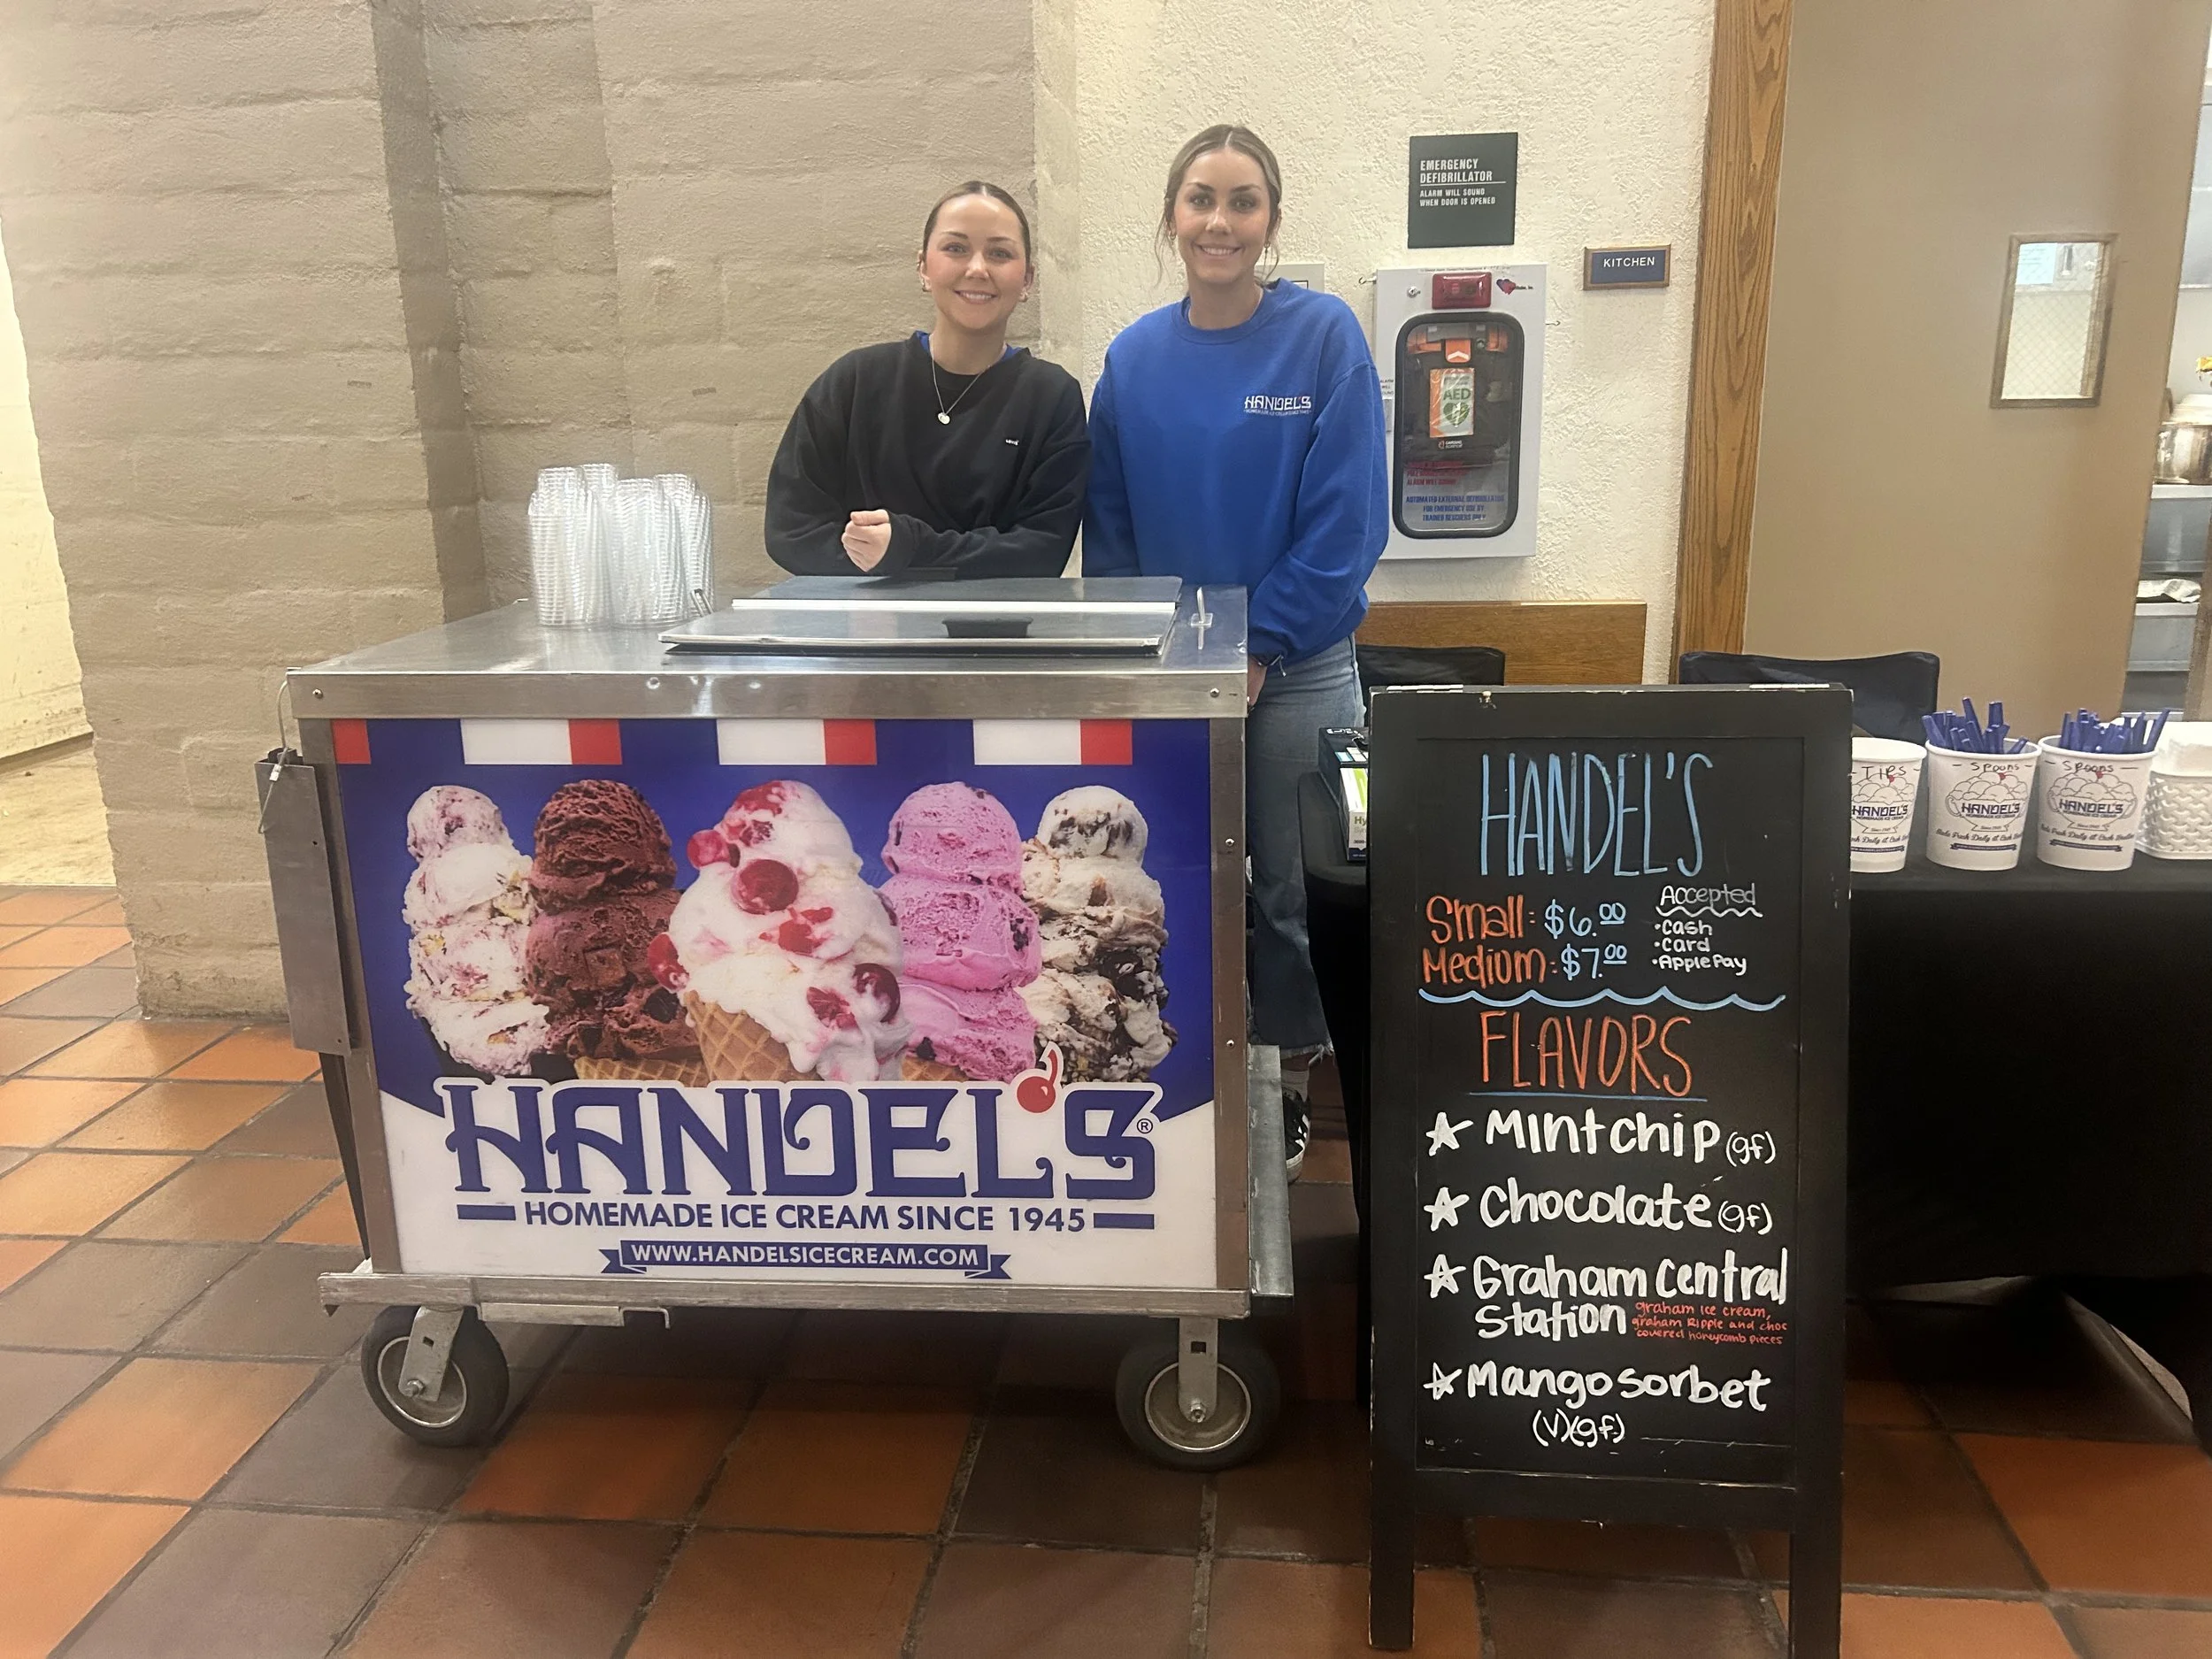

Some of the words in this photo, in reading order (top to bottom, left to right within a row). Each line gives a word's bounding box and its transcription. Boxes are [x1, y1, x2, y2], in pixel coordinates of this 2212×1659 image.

[1420, 158, 1479, 171] EMERGENCY
[1420, 171, 1493, 183] DEFIBRILLATOR
[1420, 188, 1442, 197] ALARM
[1445, 188, 1461, 197] WILL
[1463, 188, 1486, 196] SOUND
[1420, 198, 1439, 207] WHEN
[1440, 197, 1458, 206] DOOR
[1471, 196, 1495, 205] OPENED
[1603, 257, 1655, 268] KITCHEN
[1443, 388, 1471, 401] AED
[1852, 804, 1909, 817] HANDEL'S
[1962, 803, 2021, 815] HANDEL'S
[2059, 798, 2124, 814] HANDEL'S
[1479, 752, 1714, 877] HANDEL'S
[1660, 882, 1756, 909] Accepted
[1544, 898, 1627, 940] $6.00
[1560, 942, 1628, 980] $7.00
[1479, 1010, 1693, 1097] FLAVORS
[1725, 1131, 1777, 1167] (gf)
[1479, 1177, 1713, 1231] Chocolate
[1717, 1201, 1773, 1235] (gf)
[524, 1200, 712, 1229] HOMEMADE
[720, 1203, 768, 1230] ICE
[775, 1204, 889, 1231] CREAM
[897, 1206, 995, 1232] SINCE
[1008, 1207, 1085, 1233] 1945
[629, 1242, 979, 1268] WWW.HANDELSICECREAM.COM
[1472, 1254, 1647, 1300] Graham
[1635, 1302, 1694, 1318] graham
[1631, 1317, 1682, 1332] graham
[1729, 1320, 1755, 1330] and
[1636, 1329, 1685, 1339] covered
[1749, 1335, 1783, 1345] pieces
[1468, 1360, 1613, 1409] Mango
